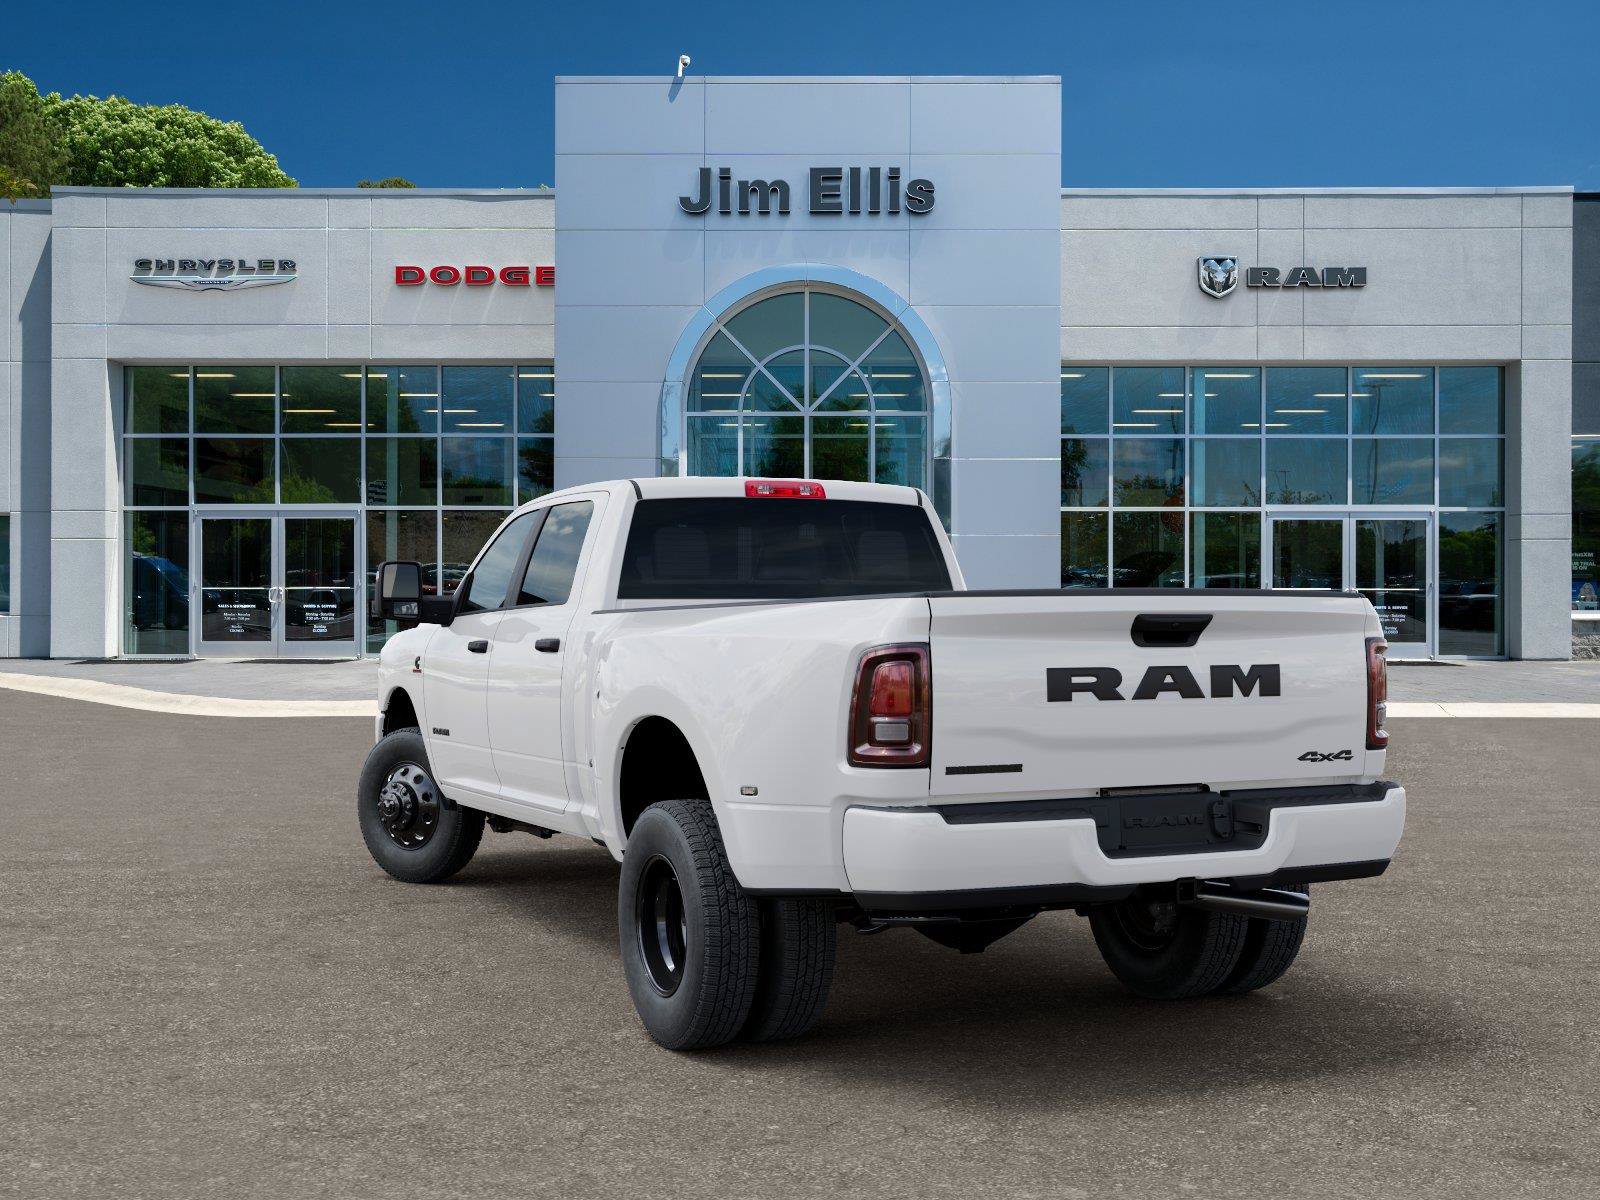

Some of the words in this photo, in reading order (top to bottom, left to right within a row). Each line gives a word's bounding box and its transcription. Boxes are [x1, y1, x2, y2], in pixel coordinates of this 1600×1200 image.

[679, 167, 790, 214] Jim
[809, 167, 935, 215] Ellis
[134, 258, 297, 272] CHRYSLER
[395, 266, 555, 287] DODGE
[1246, 266, 1367, 287] RAM
[1046, 663, 1281, 702] RAM
